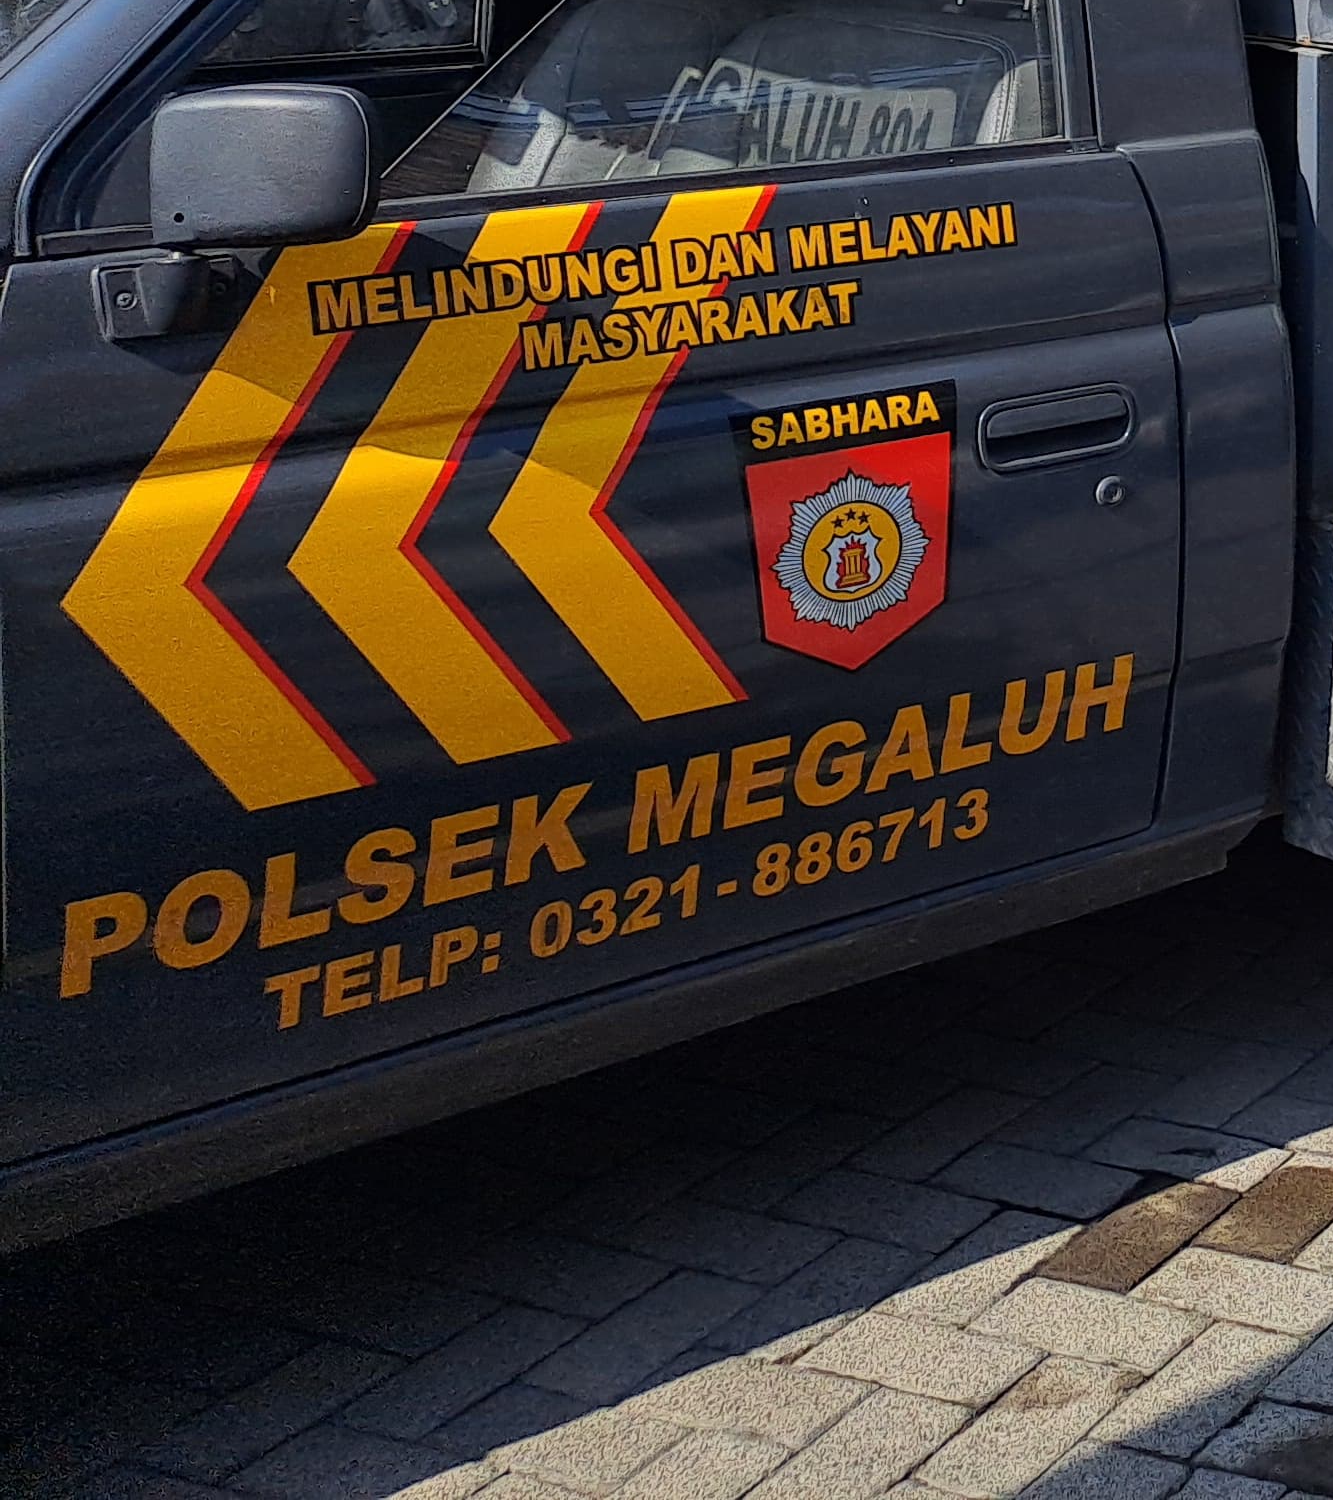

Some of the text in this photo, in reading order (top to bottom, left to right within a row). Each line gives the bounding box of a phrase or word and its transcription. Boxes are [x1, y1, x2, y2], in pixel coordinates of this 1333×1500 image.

[309, 202, 1017, 334] MELINDUNGI DAN MELAYANI
[519, 279, 864, 375] MASYARAKAT
[751, 390, 940, 450] SABHARA
[59, 653, 1135, 999] POLSEK MEGALUH
[264, 925, 502, 1032] TELP:
[529, 863, 701, 958] 0321
[752, 788, 990, 898] 886713
